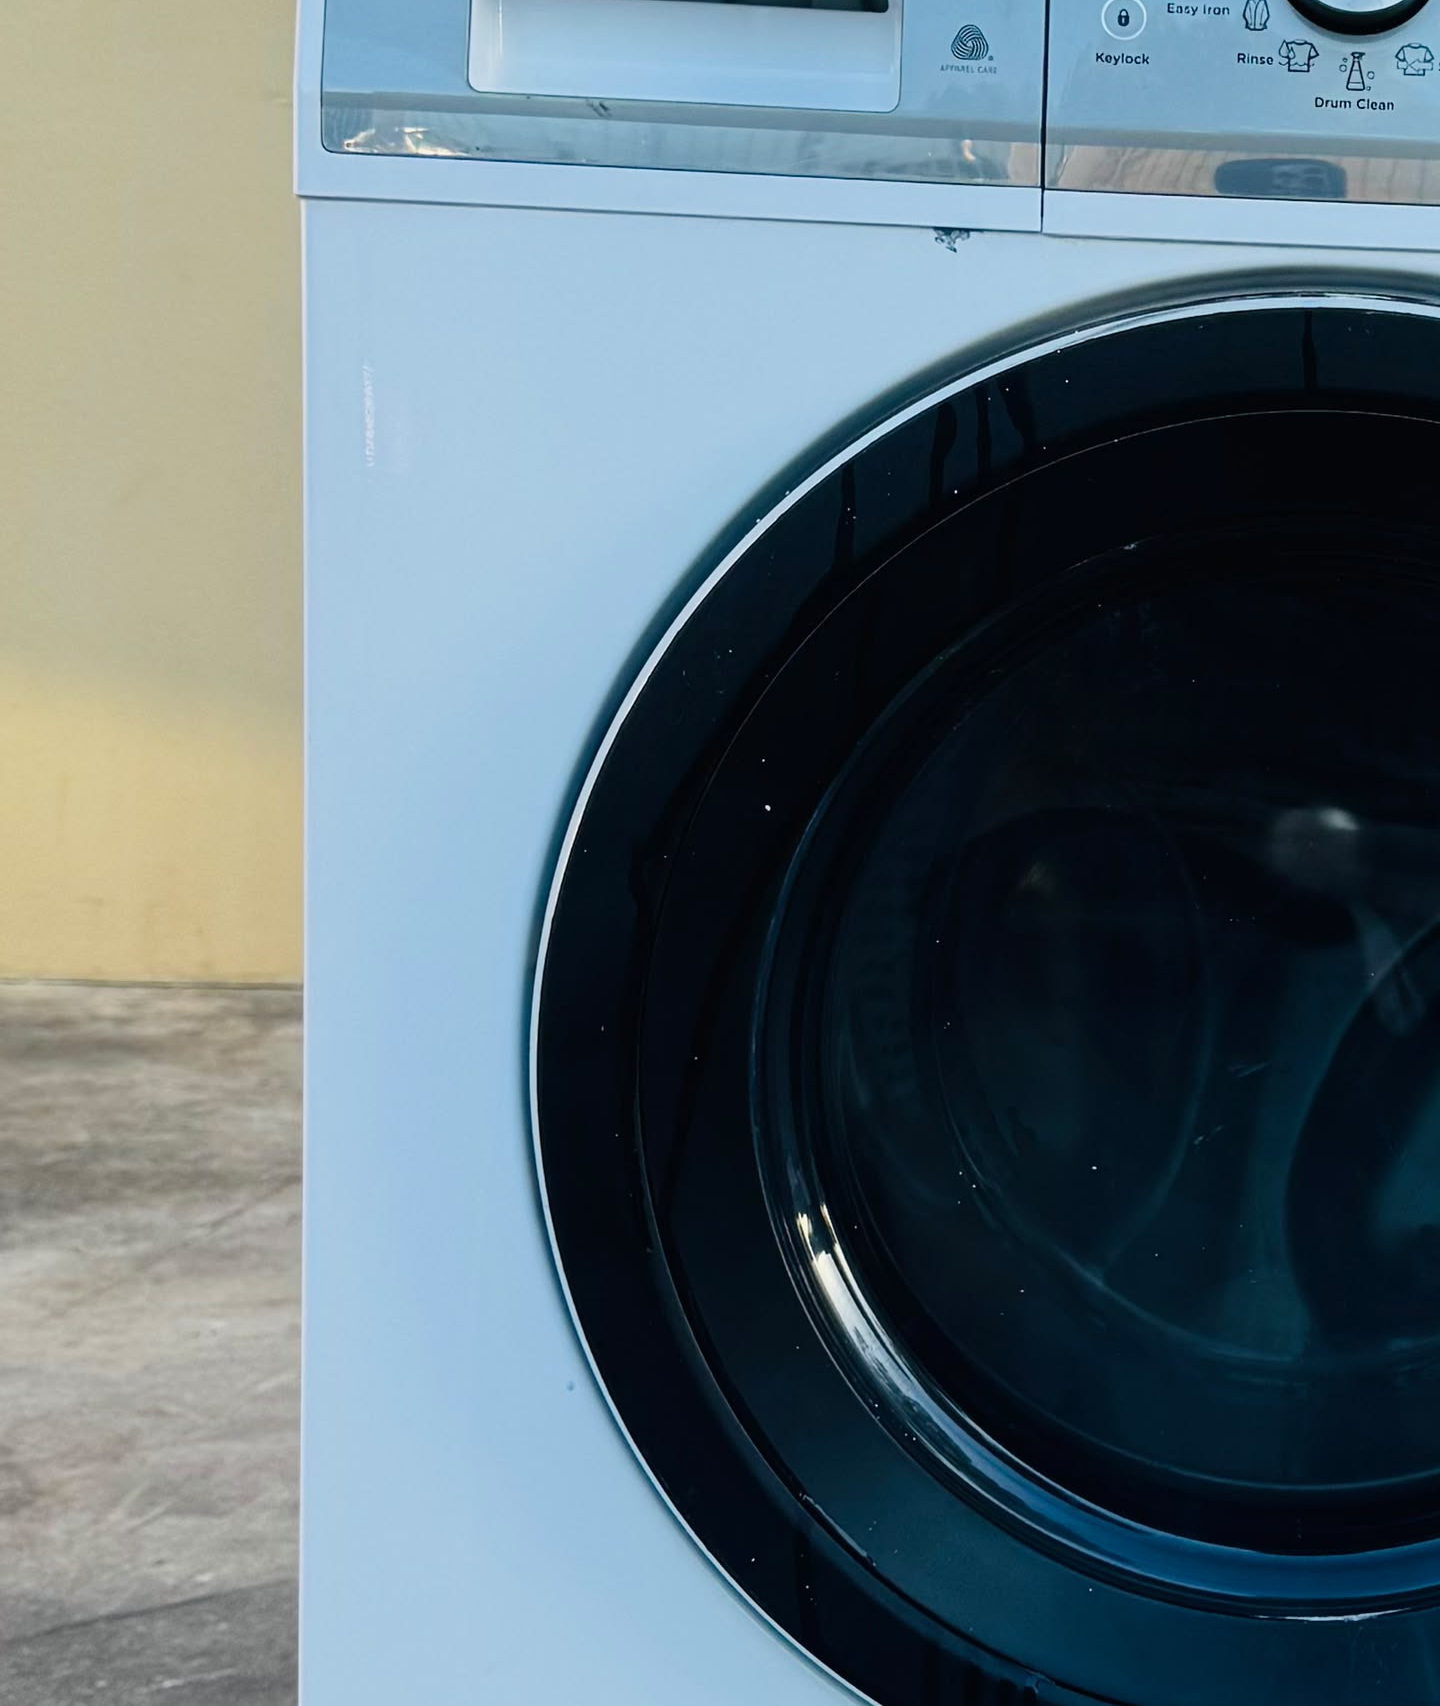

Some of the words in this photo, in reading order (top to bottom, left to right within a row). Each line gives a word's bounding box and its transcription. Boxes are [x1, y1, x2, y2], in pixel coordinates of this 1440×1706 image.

[1167, 3, 1198, 16] Easy
[1095, 52, 1150, 65] Keylock
[1237, 52, 1274, 65] Rinse
[1314, 97, 1351, 109] Drum
[1356, 98, 1394, 111] Clean
